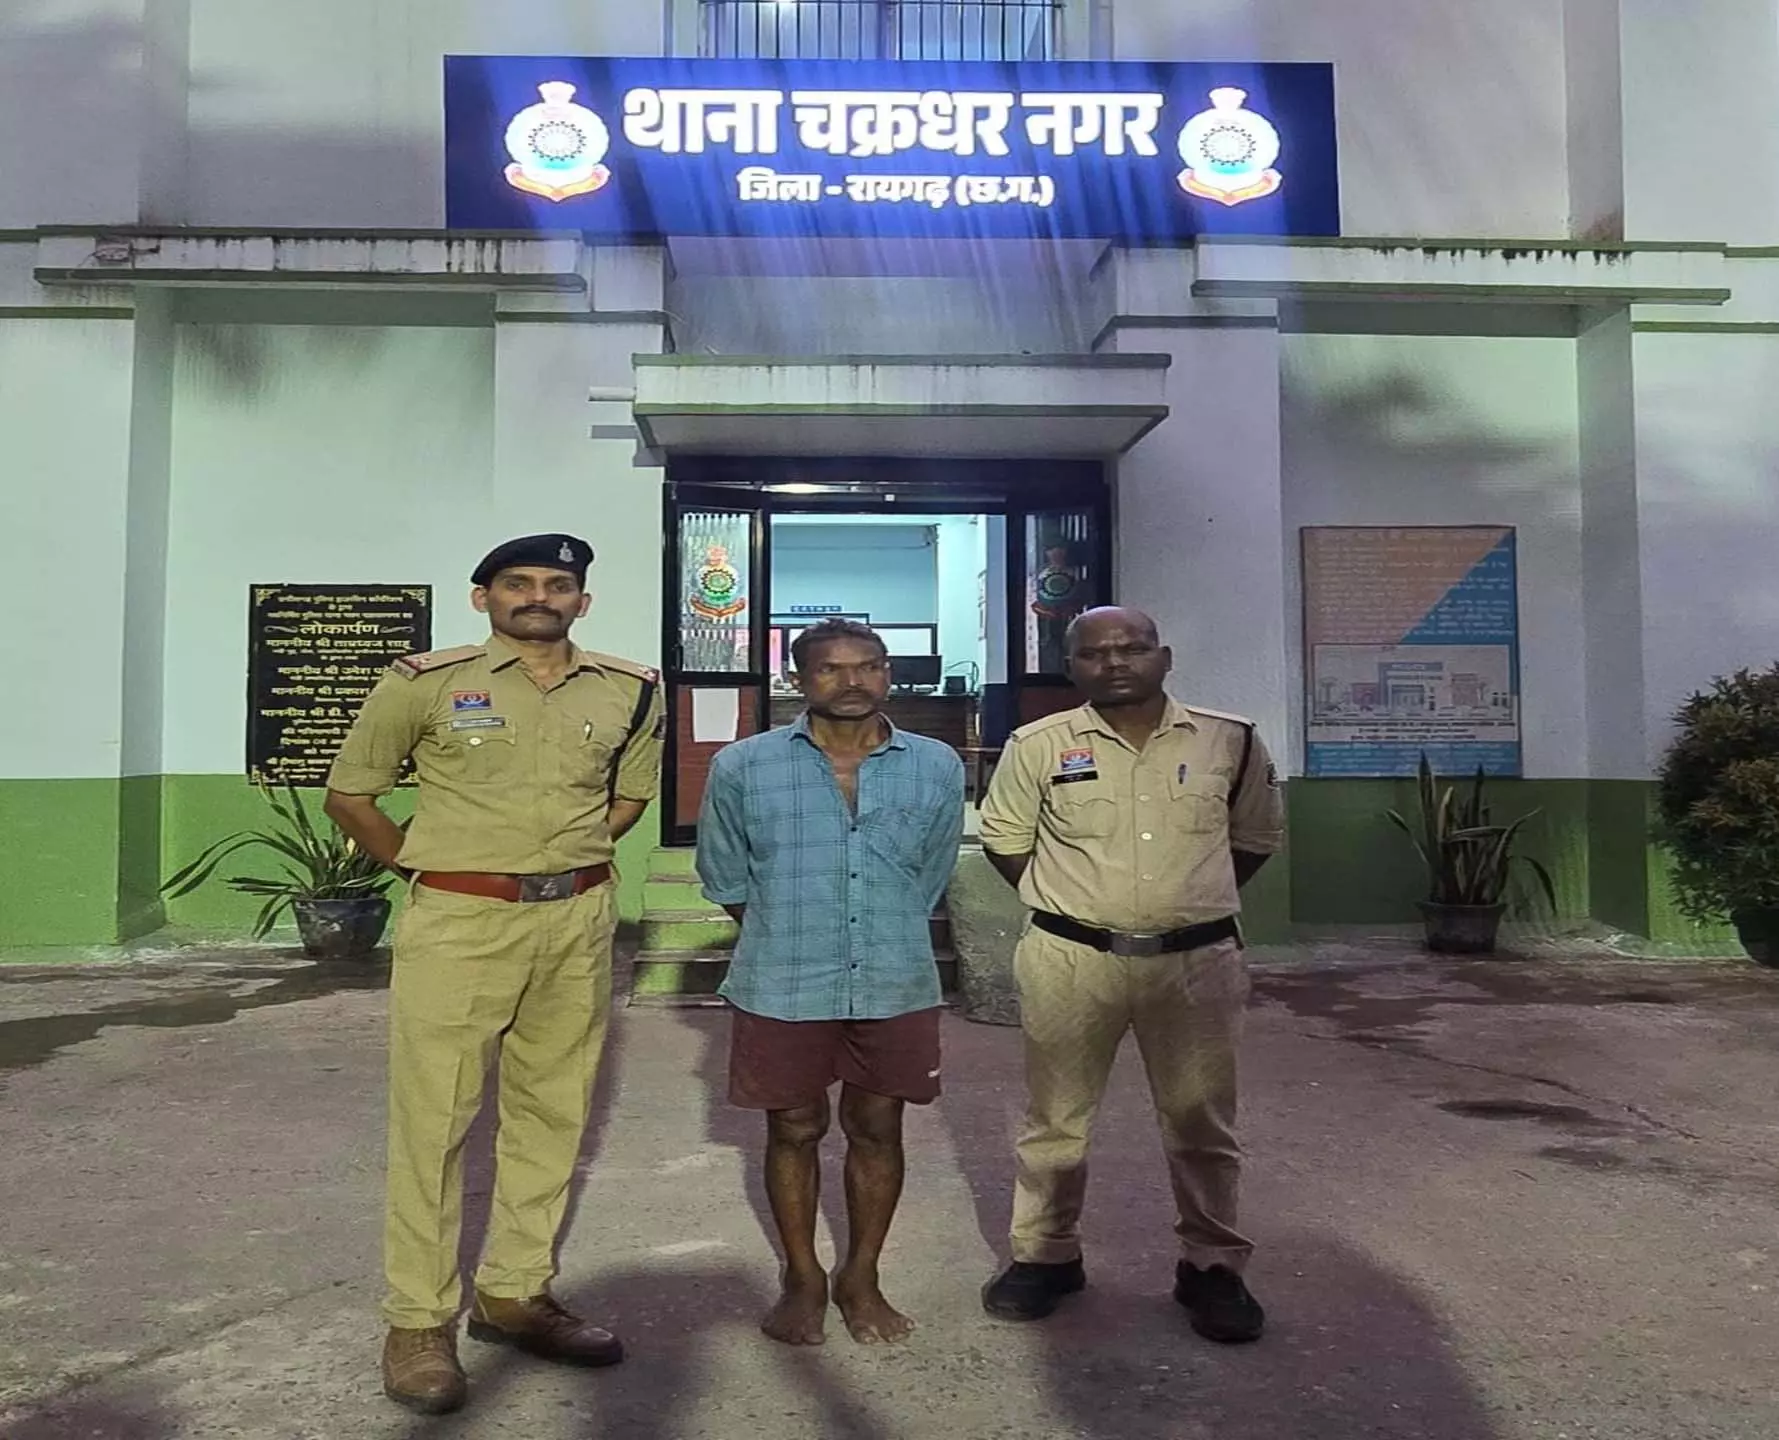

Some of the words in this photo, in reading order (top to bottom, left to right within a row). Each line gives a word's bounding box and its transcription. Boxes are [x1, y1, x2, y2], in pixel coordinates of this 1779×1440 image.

[623, 88, 783, 154] थाना
[791, 90, 1014, 156] चक्रधर
[1021, 92, 1164, 156] नगर
[736, 167, 823, 201] जिला
[846, 175, 951, 208] रायगढ़
[299, 620, 380, 635] लोकार्पण
